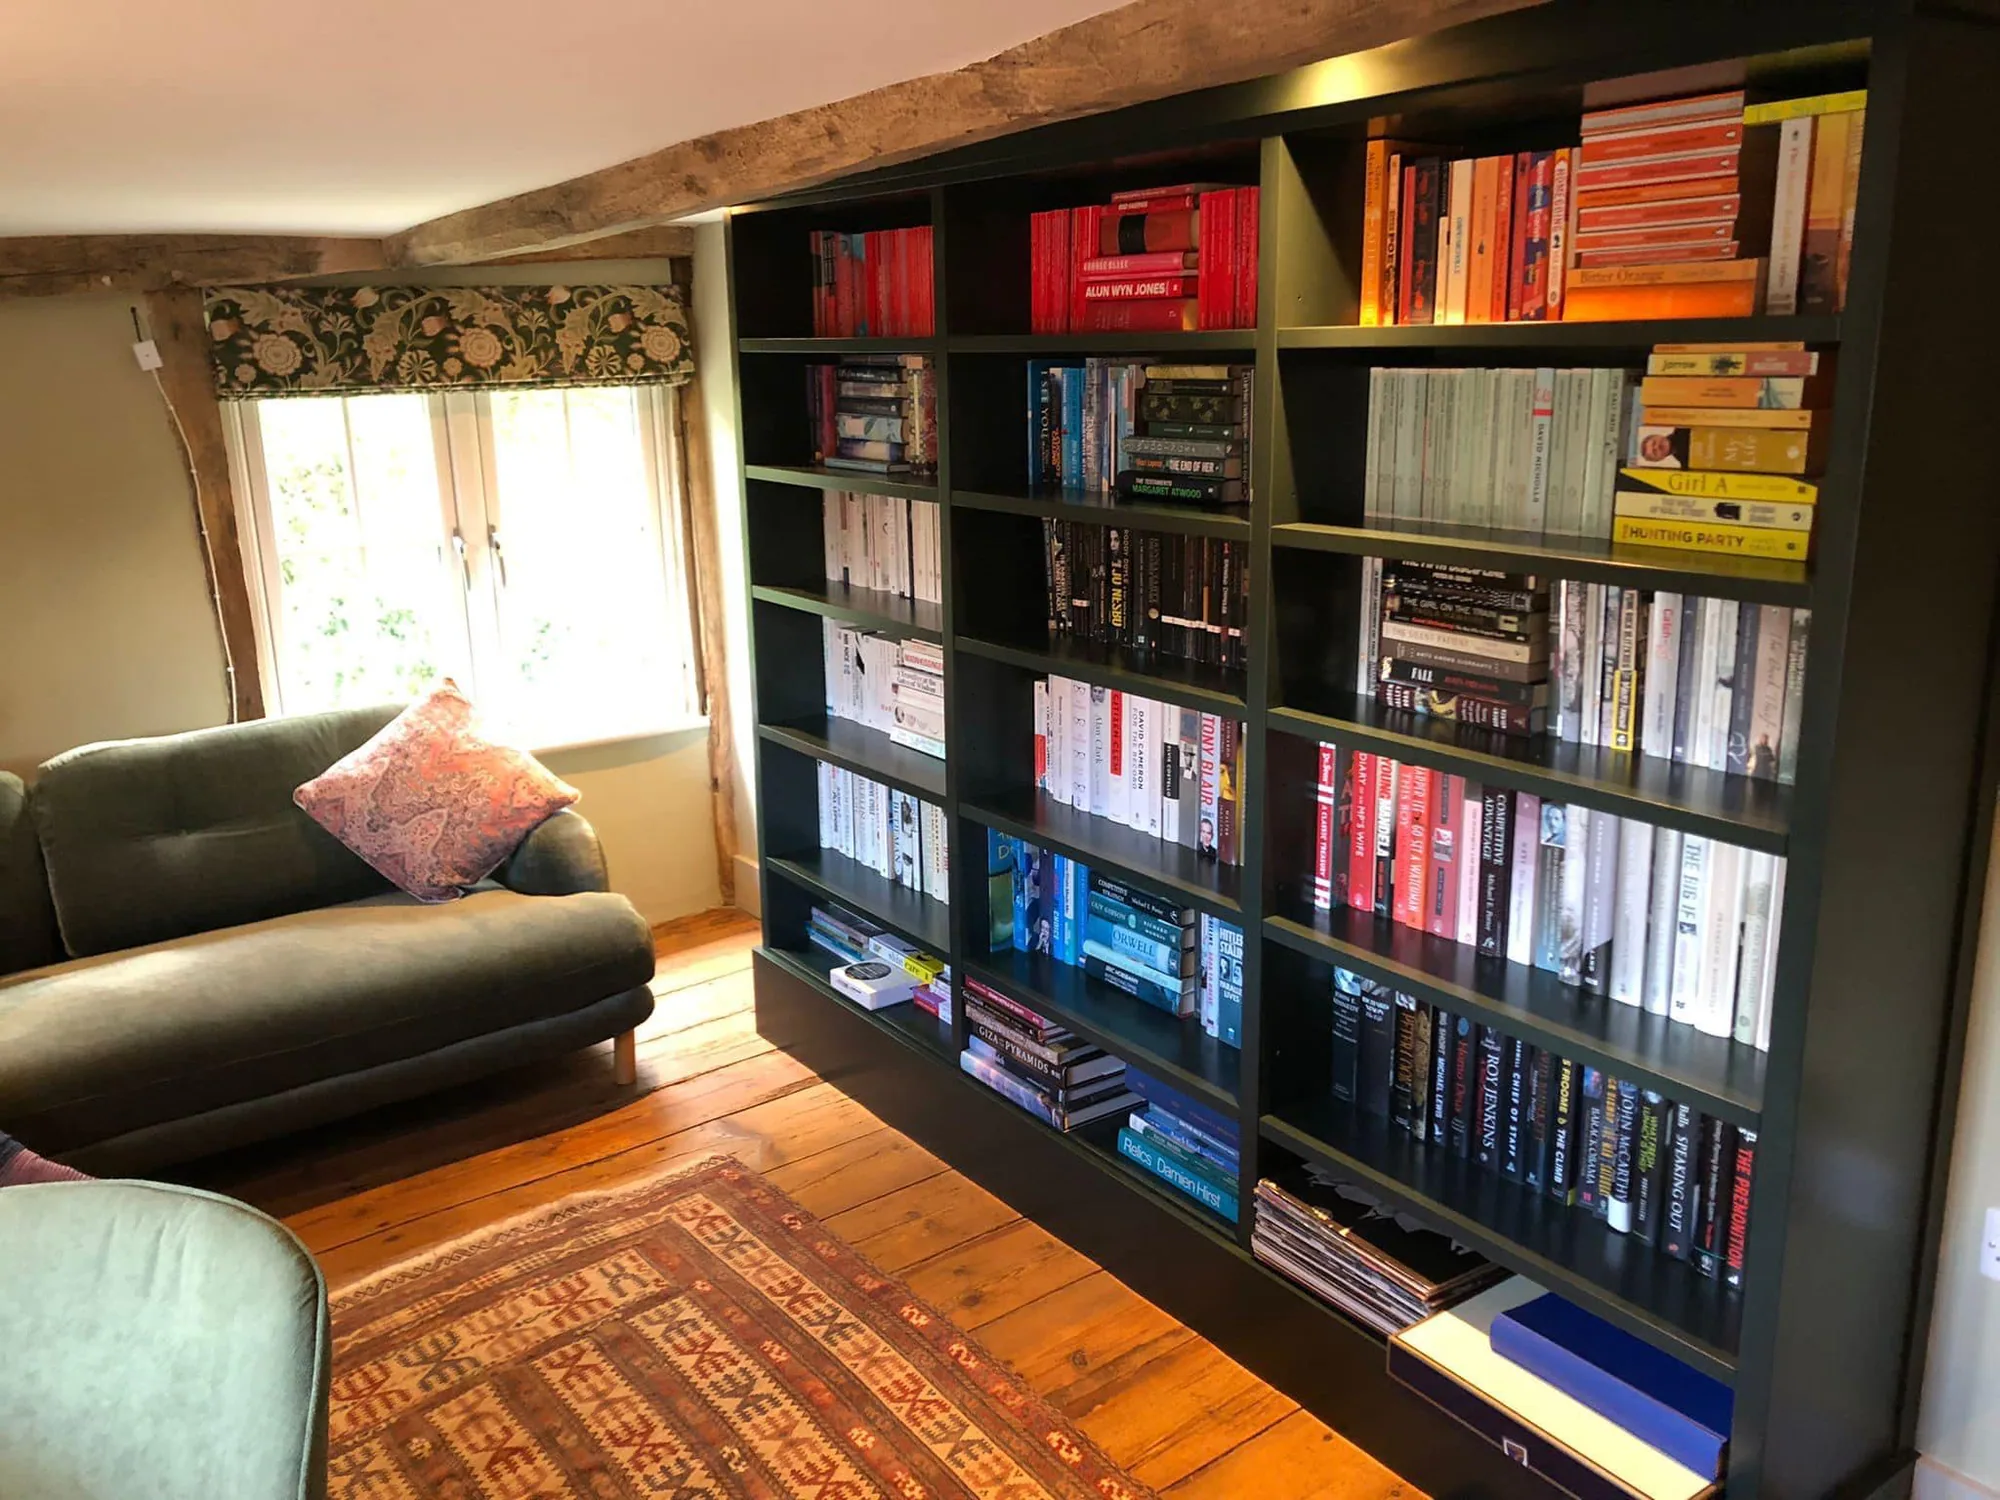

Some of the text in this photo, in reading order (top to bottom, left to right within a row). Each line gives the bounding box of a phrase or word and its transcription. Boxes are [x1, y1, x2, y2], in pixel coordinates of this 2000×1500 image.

[1086, 282, 1166, 298] ALUN WYN JONES
[1580, 270, 1664, 284] Bitter Orange
[1040, 407, 1049, 437] YOU
[1533, 422, 1545, 504] DAVID NICHOLLS
[1132, 484, 1168, 496] MARGARET
[1668, 473, 1728, 494] Girl A
[1630, 528, 1692, 544] HUNTING
[1696, 532, 1745, 548] PARTY
[1403, 596, 1418, 608] THE
[1419, 599, 1438, 611] GIRL
[1440, 602, 1454, 613] ON
[1455, 604, 1472, 616] THE
[1766, 632, 1784, 650] The
[1095, 715, 1103, 736] Alan
[1112, 693, 1120, 738] CITIZEN
[1201, 716, 1216, 806] TONY BLAIR
[1358, 753, 1368, 785] DIARY
[1165, 763, 1173, 798] COSTELLO
[1376, 757, 1392, 857] YOUNG MANDELA
[1400, 773, 1410, 828] THIS BOY
[1411, 800, 1425, 814] LEE
[1320, 811, 1329, 840] CLASSIC
[1357, 805, 1367, 829] MP'S
[1411, 824, 1424, 838] GO
[1483, 796, 1495, 859] ADVANTAGE
[1494, 794, 1507, 866] COMPETITIVE
[1319, 841, 1328, 878] TREASURY
[1355, 831, 1365, 857] WIFE
[1410, 840, 1424, 854] SET
[1407, 863, 1423, 912] WATCHMAN
[1485, 873, 1495, 901] Michael
[1681, 844, 1701, 920] THE BIG IF
[1219, 927, 1244, 947] HITLER
[1483, 912, 1492, 931] Porter
[1113, 930, 1157, 958] ORWELL
[1219, 940, 1244, 961] STALIN
[978, 1025, 998, 1046] GIZA
[1005, 1042, 1049, 1075] PYRAMIDS
[1397, 1012, 1416, 1086] PETER COOK
[1434, 1011, 1448, 1119] BIG SHORT MICHAEL LEWIS
[1454, 1039, 1467, 1113] Homo Deus
[1511, 1072, 1522, 1104] CHIEF
[1482, 1053, 1500, 1149] ROY JENKINS
[1509, 1107, 1518, 1122] OF
[1554, 1068, 1571, 1184] FROOME THE CLIMB
[1639, 1106, 1651, 1141] LUNACY
[1507, 1126, 1518, 1157] STAFF
[1586, 1107, 1600, 1185] BARACK OBAMA
[1614, 1093, 1636, 1203] JOHN McCARTHY
[1645, 1115, 1659, 1171] WHAT FRESH
[1123, 1137, 1152, 1166] Relics
[1157, 1157, 1196, 1191] Damien
[1197, 1180, 1221, 1209] Hirst
[1669, 1104, 1690, 1233] Balls SPEAKING OUT
[1736, 1147, 1753, 1173] THE
[1727, 1176, 1750, 1270] PREMONITION
